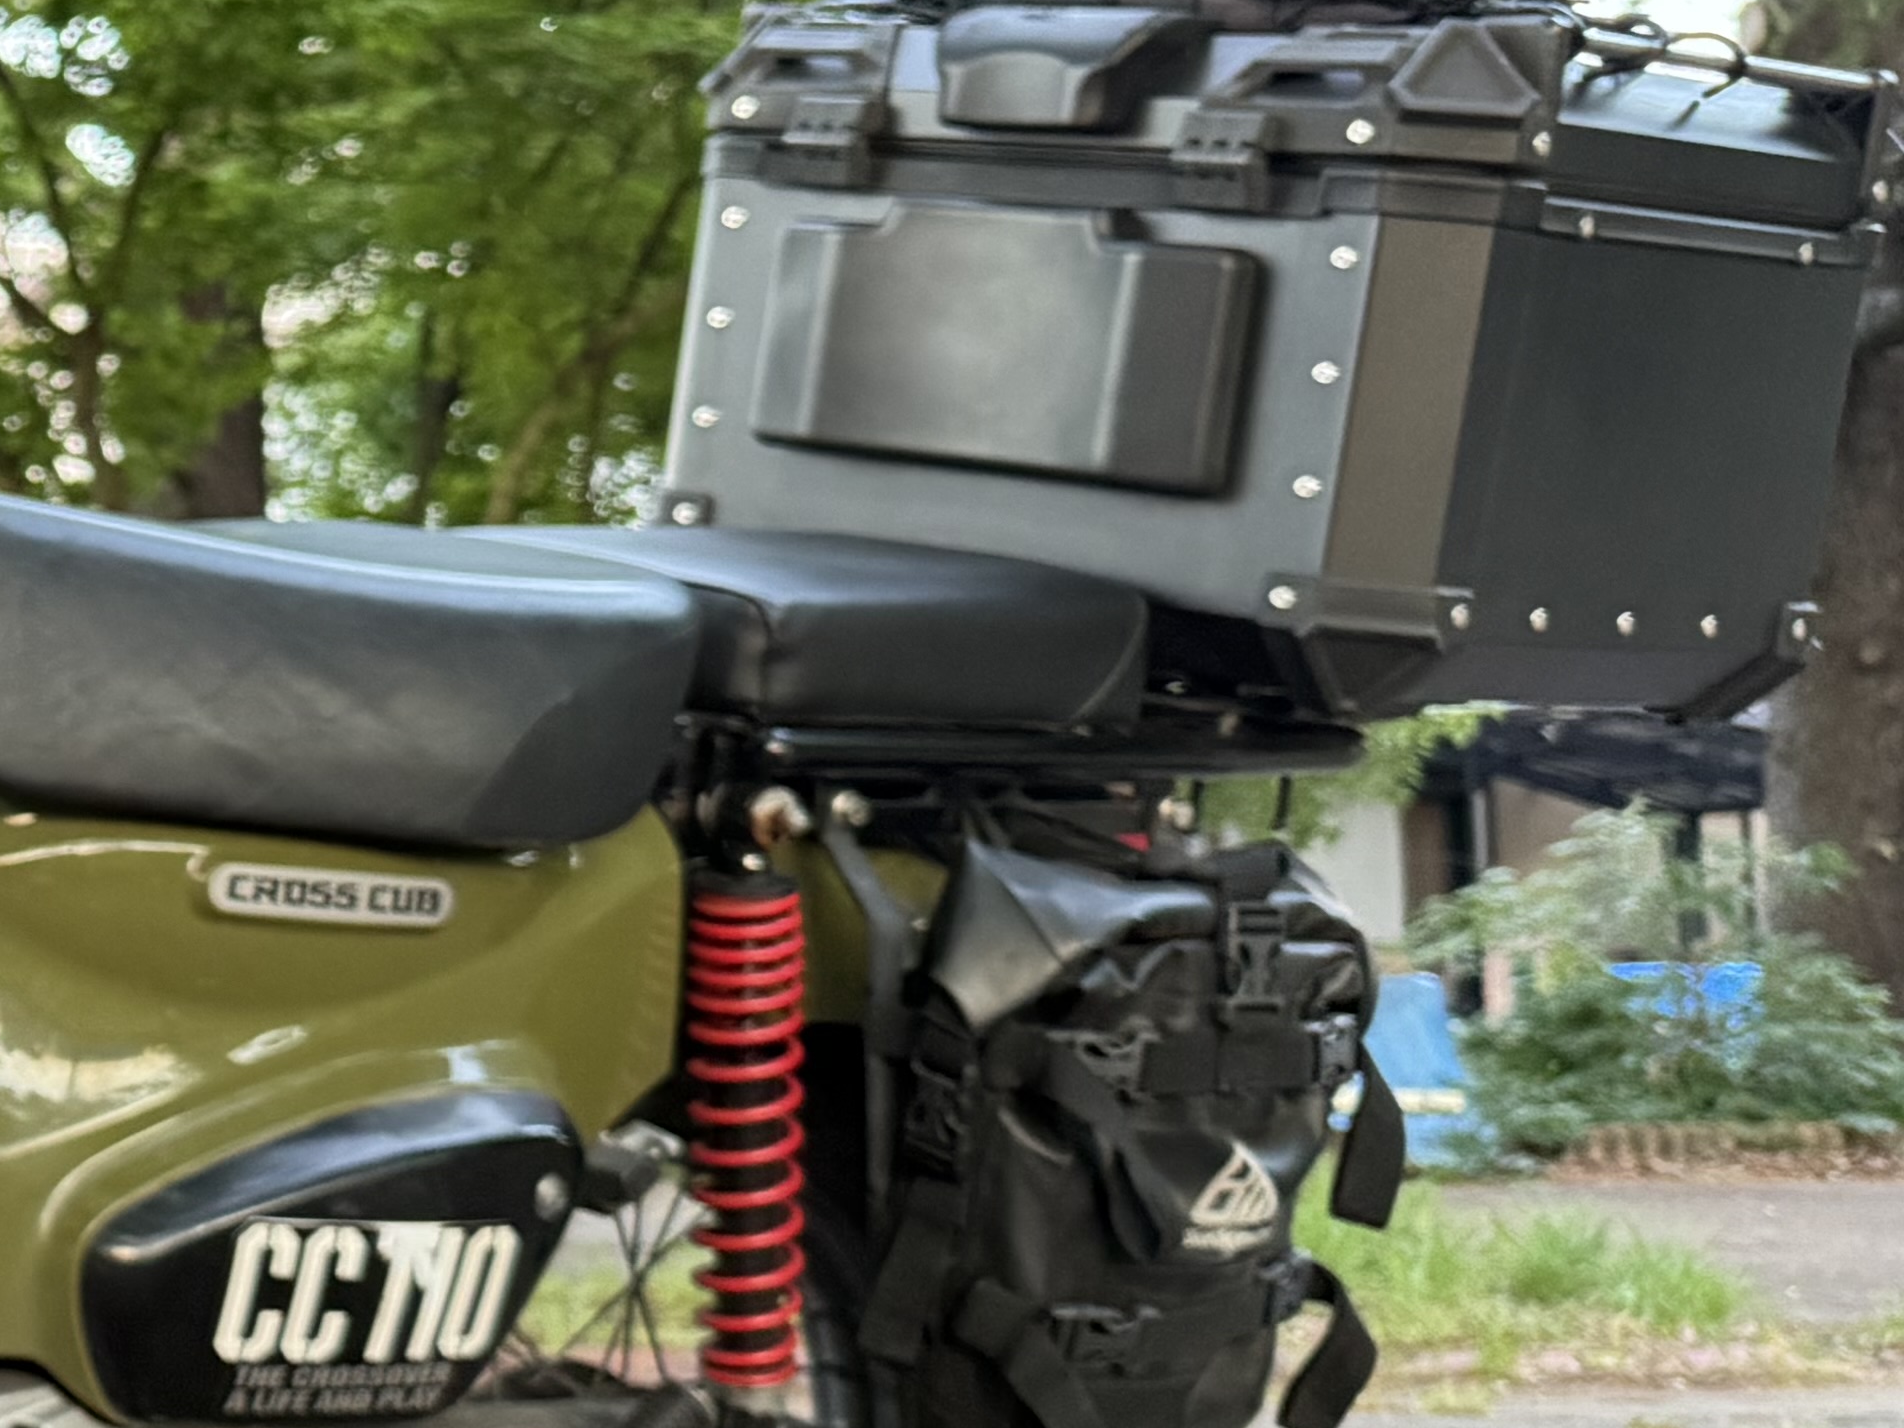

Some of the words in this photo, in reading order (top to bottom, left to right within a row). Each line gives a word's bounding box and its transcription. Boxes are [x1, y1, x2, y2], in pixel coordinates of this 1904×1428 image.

[228, 874, 358, 911] CROSS
[367, 883, 442, 916] CUB
[234, 1364, 287, 1387] THE
